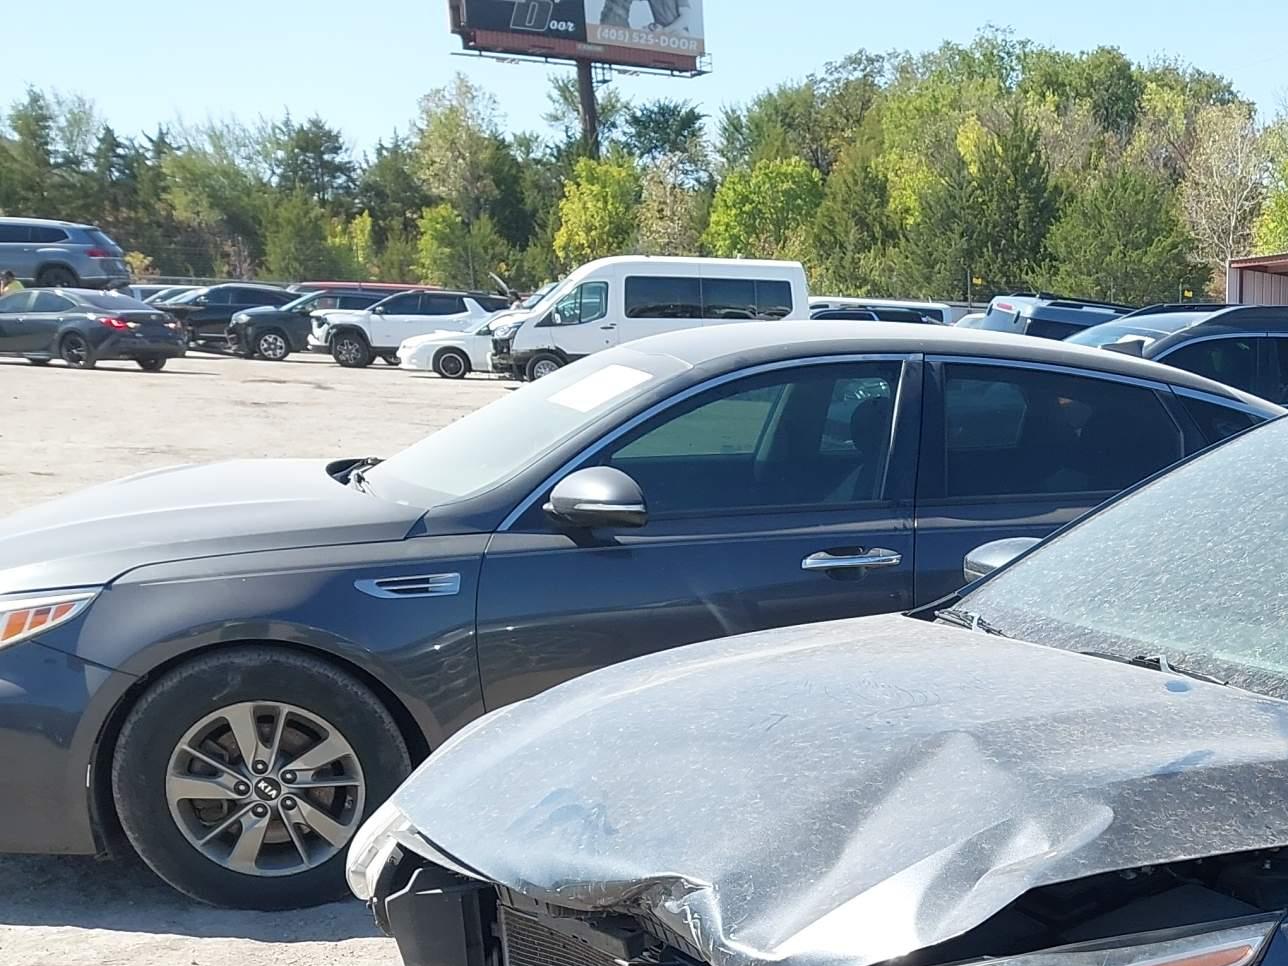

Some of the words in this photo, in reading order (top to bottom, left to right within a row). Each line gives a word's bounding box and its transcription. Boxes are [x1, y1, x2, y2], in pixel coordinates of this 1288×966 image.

[595, 26, 629, 43] (405)
[631, 32, 698, 51] 525-DOOR
[257, 780, 279, 799] KIA
